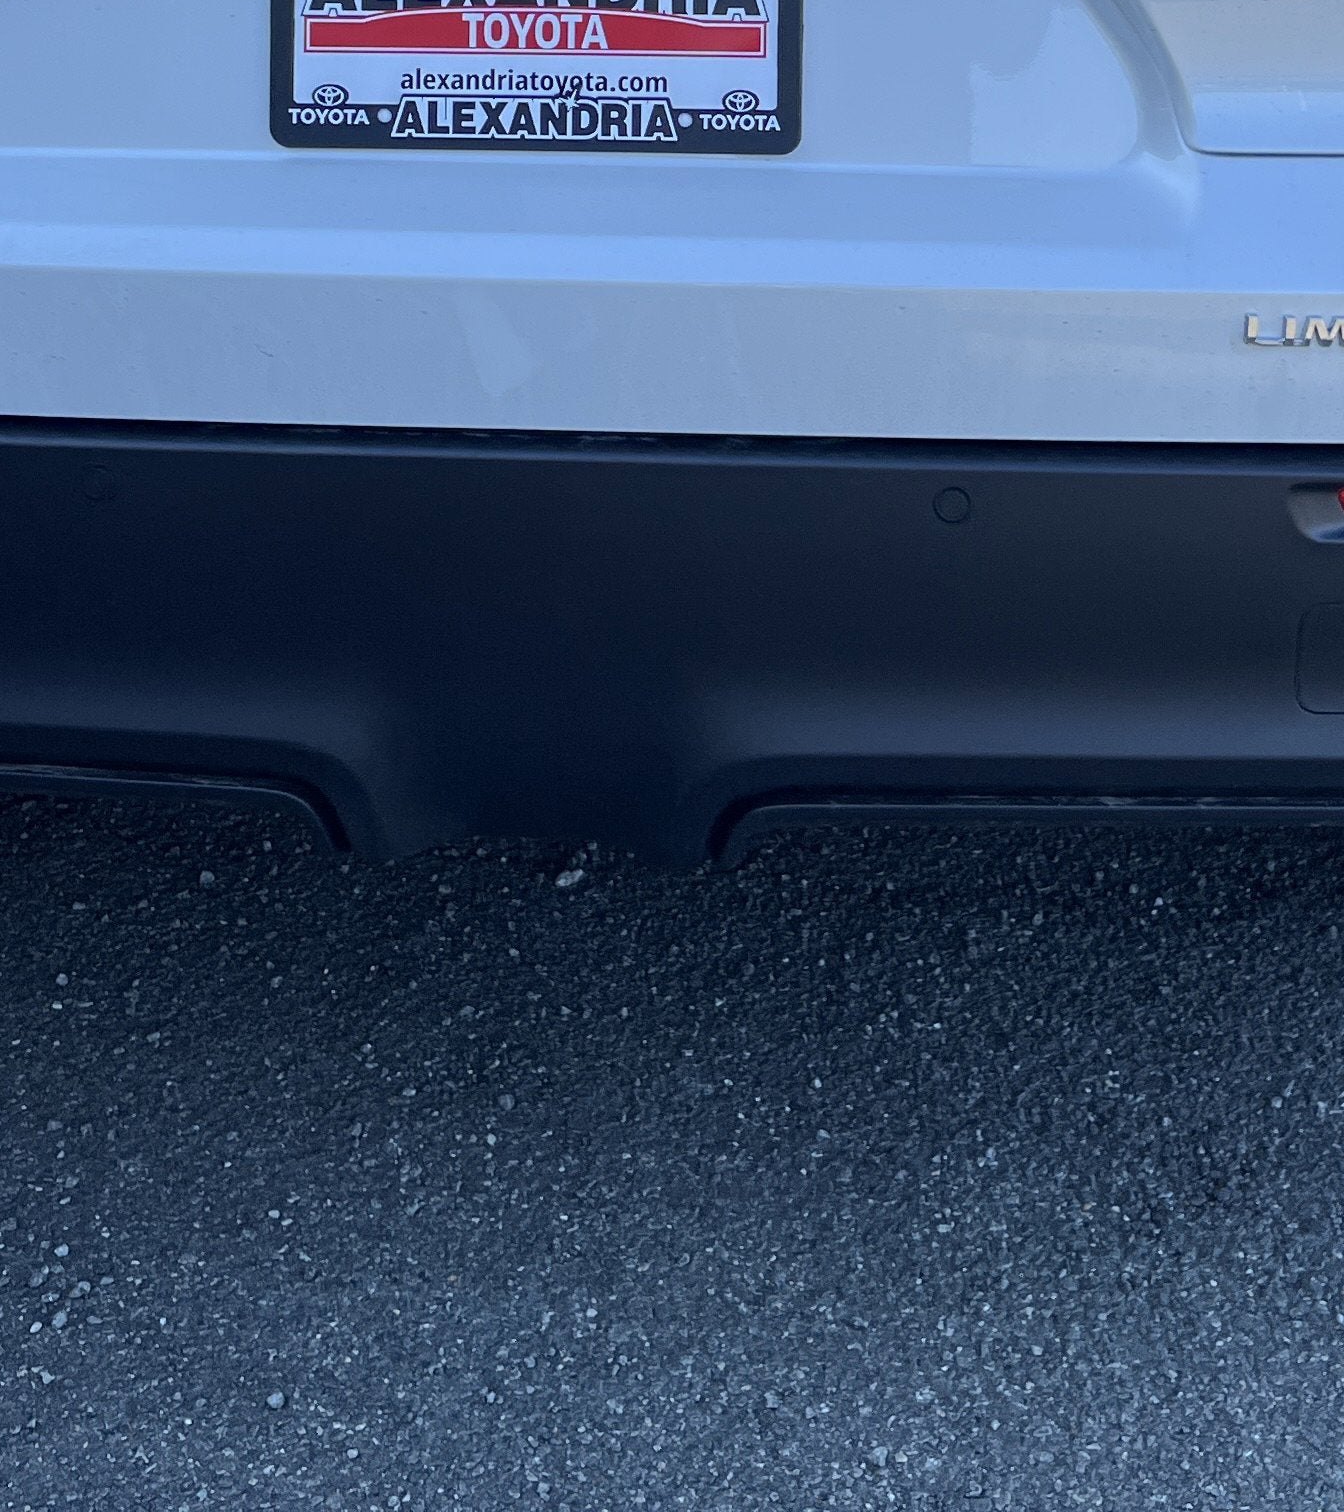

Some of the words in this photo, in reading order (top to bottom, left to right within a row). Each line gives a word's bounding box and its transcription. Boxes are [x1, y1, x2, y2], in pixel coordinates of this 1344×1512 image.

[461, 13, 608, 50] TOYOTA
[400, 68, 668, 94] alexandriatoyota.com
[288, 108, 370, 126] TOYOTA
[391, 95, 678, 142] ALEXANDRIA
[699, 113, 780, 132] TOYOTA
